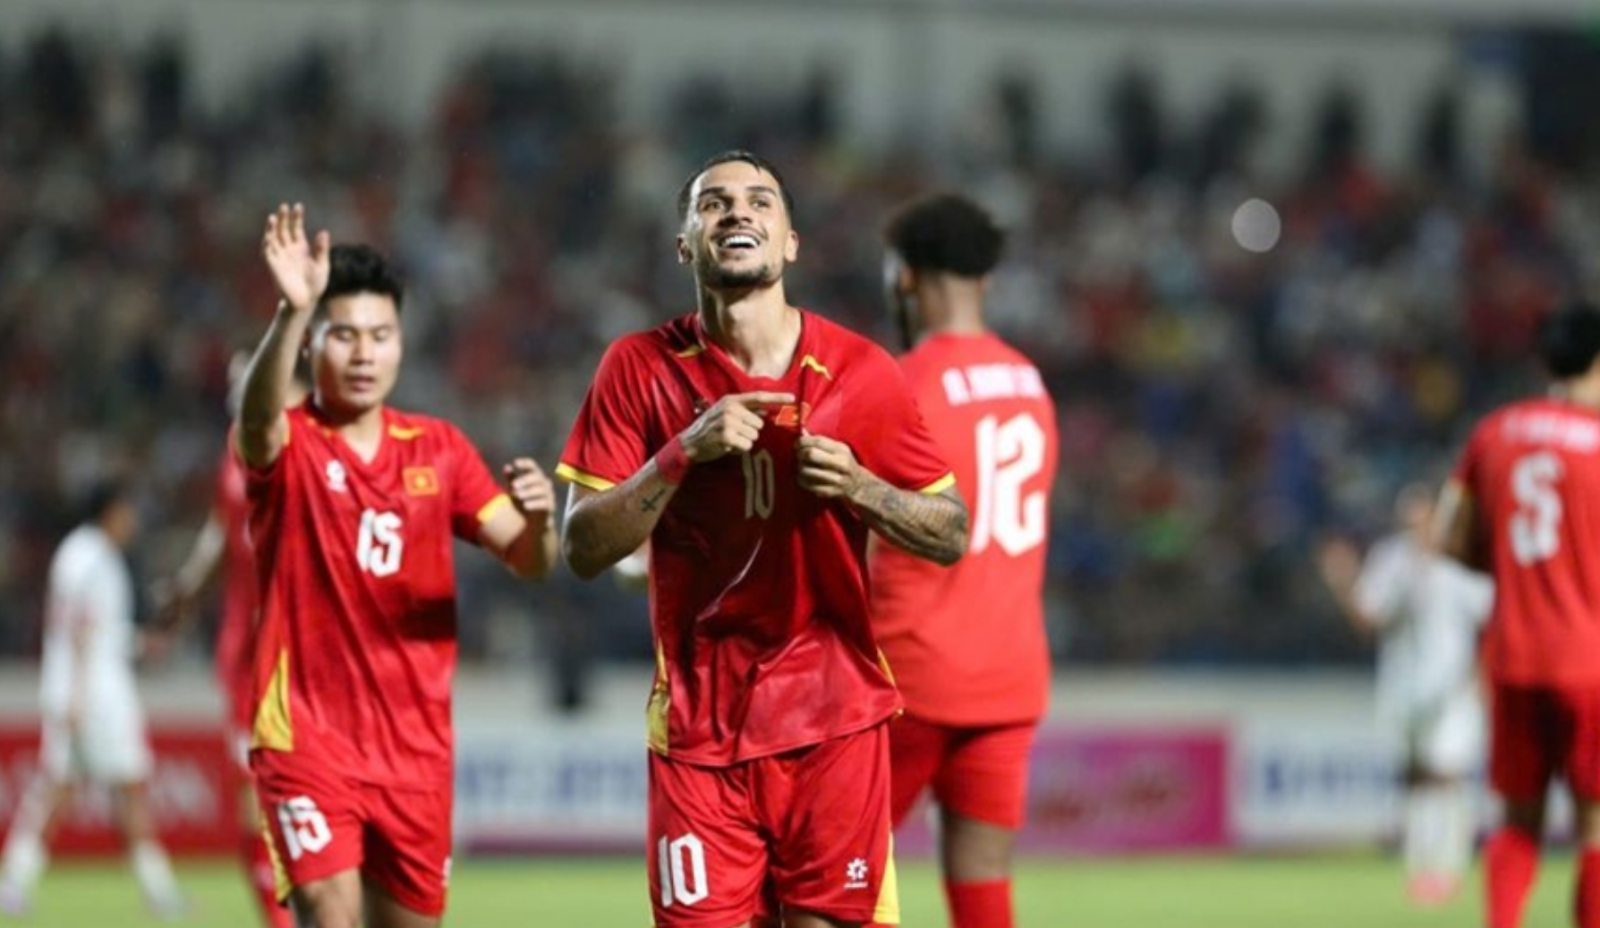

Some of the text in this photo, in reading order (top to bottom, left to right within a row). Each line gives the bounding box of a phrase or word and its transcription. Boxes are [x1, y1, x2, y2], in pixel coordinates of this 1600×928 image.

[741, 448, 775, 520] 10
[970, 411, 1046, 557] 12
[356, 507, 403, 577] 15
[278, 795, 333, 861] 15
[657, 832, 709, 908] 10
